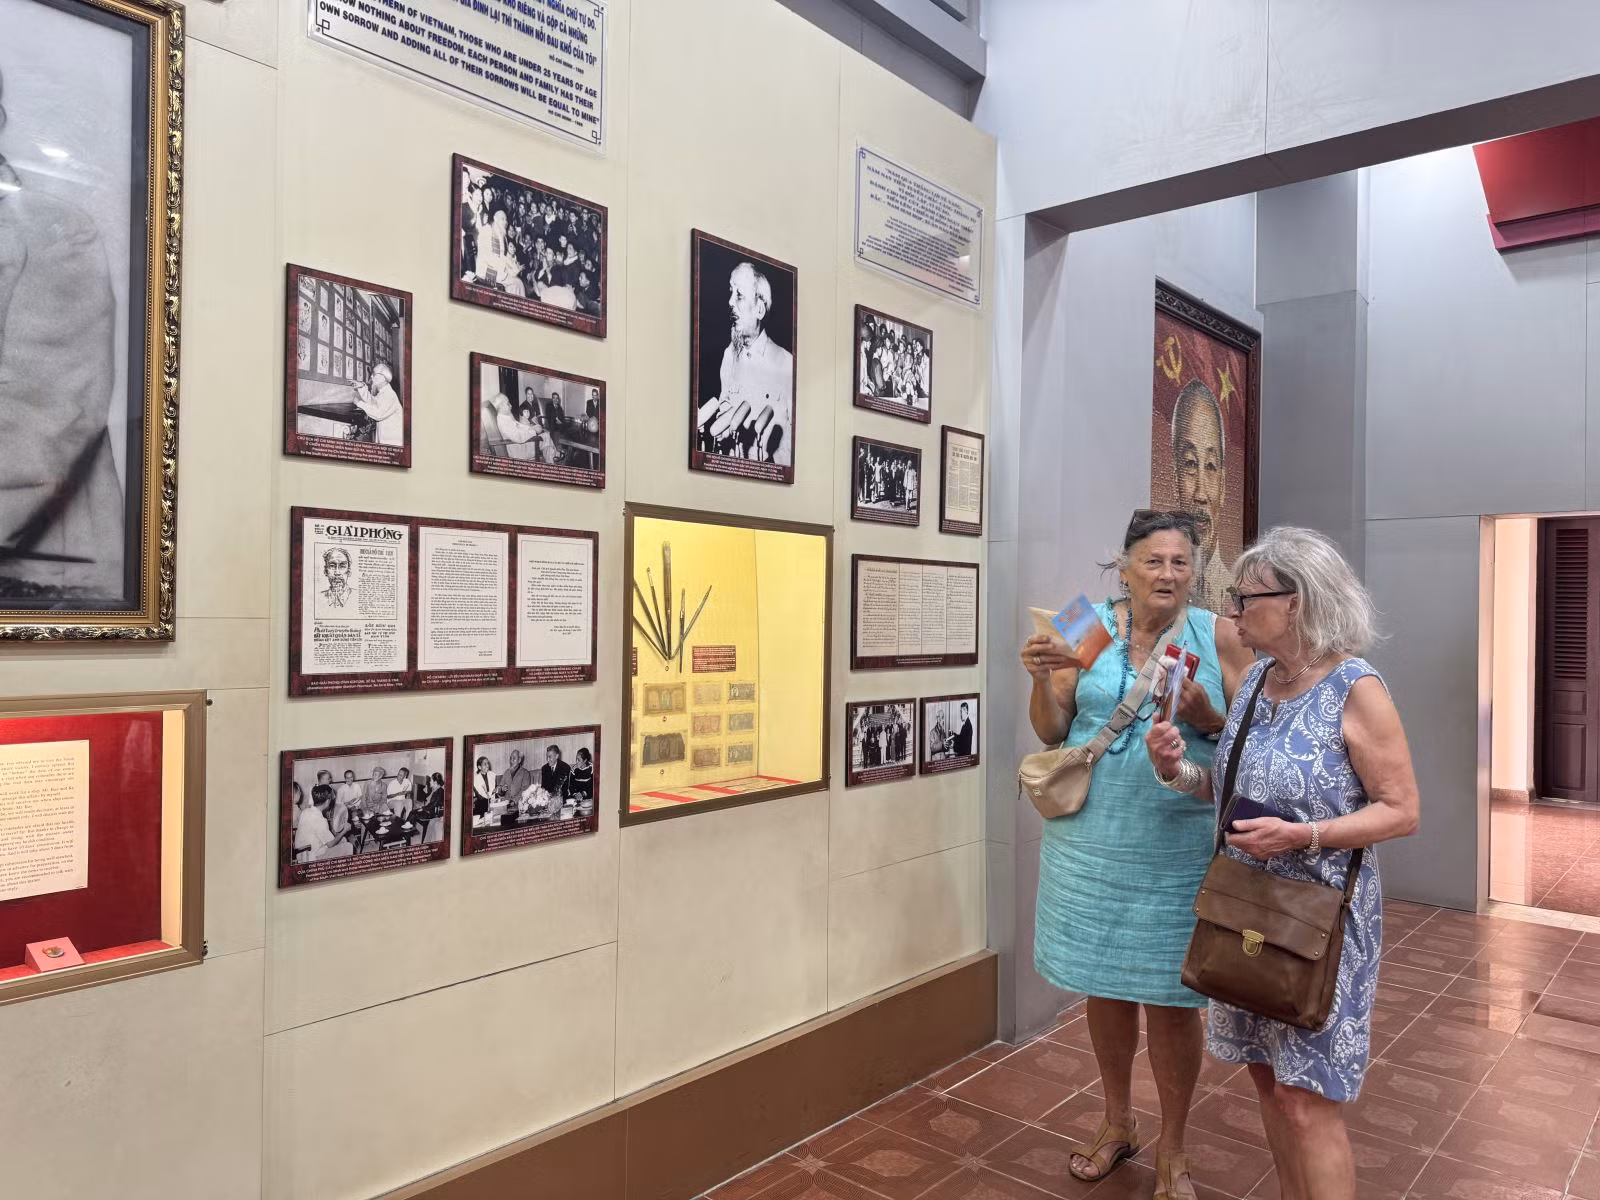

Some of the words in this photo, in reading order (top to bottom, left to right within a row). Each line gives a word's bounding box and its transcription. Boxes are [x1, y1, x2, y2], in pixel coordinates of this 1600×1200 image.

[320, 1, 340, 16] OWN
[343, 11, 379, 32] SORROW
[382, 27, 398, 40] AND
[401, 35, 431, 55] ADDING
[433, 49, 447, 61] ALL
[450, 56, 459, 65] OF
[462, 60, 483, 76] THEIR
[485, 71, 518, 91] SORROWS
[521, 85, 536, 99] WILL
[539, 93, 547, 103] BE
[549, 98, 570, 113] EQUAL
[572, 107, 580, 117] TO
[358, 1, 396, 25] NOTHING
[399, 19, 425, 37] ABOUT
[428, 31, 466, 55] FREEDOM.
[468, 49, 487, 64] EACH
[490, 58, 517, 77] PERSON
[520, 72, 533, 83] AND
[535, 78, 559, 94] FAMILY
[561, 89, 573, 101] HAS
[575, 95, 593, 110] THEIR
[407, 8, 417, 18] OF
[420, 13, 456, 38] VIETNAM,
[459, 30, 483, 48] THOSE
[485, 42, 501, 55] WHO
[503, 50, 517, 62] ARE
[519, 57, 541, 74] UNDER
[544, 68, 551, 77] 25
[553, 72, 573, 87] YEARS
[575, 82, 583, 91] OF
[585, 87, 597, 98] AGE
